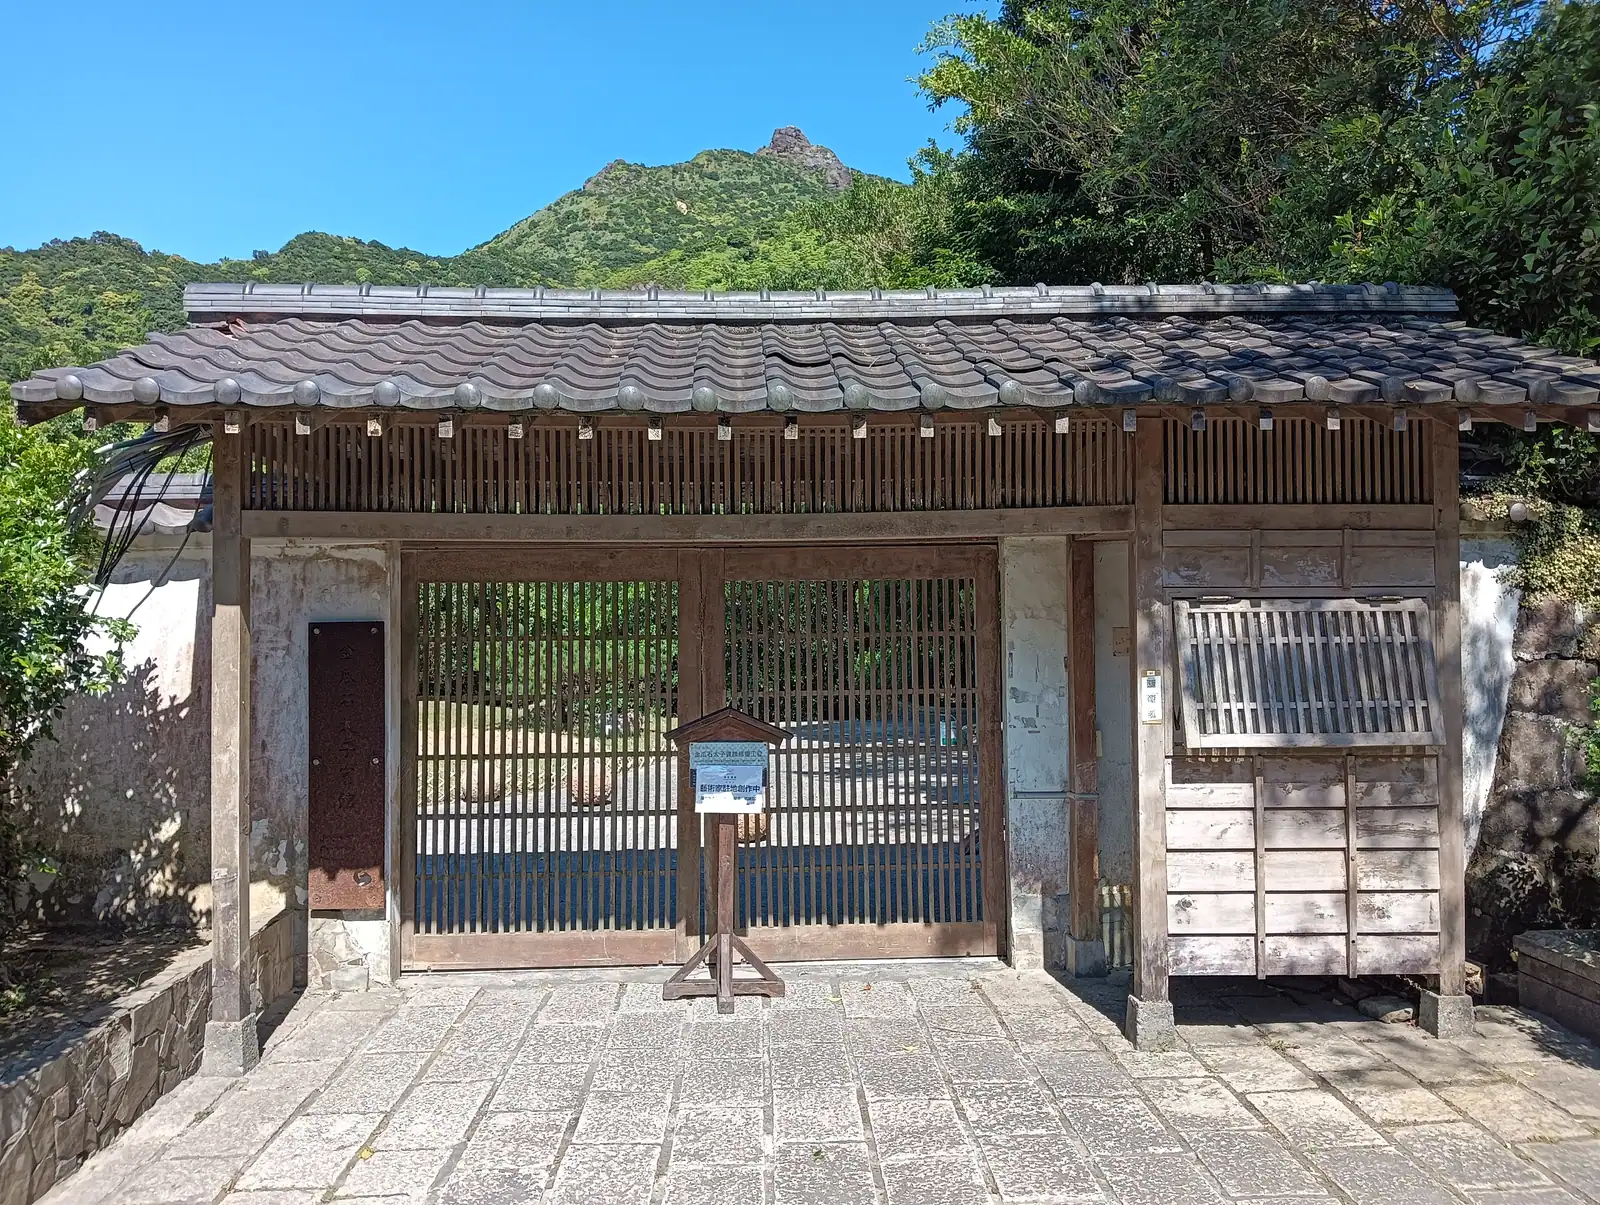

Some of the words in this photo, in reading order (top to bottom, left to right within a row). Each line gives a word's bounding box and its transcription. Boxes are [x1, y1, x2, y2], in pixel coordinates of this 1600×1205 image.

[700, 784, 760, 793] 藝術家駐地創作中
